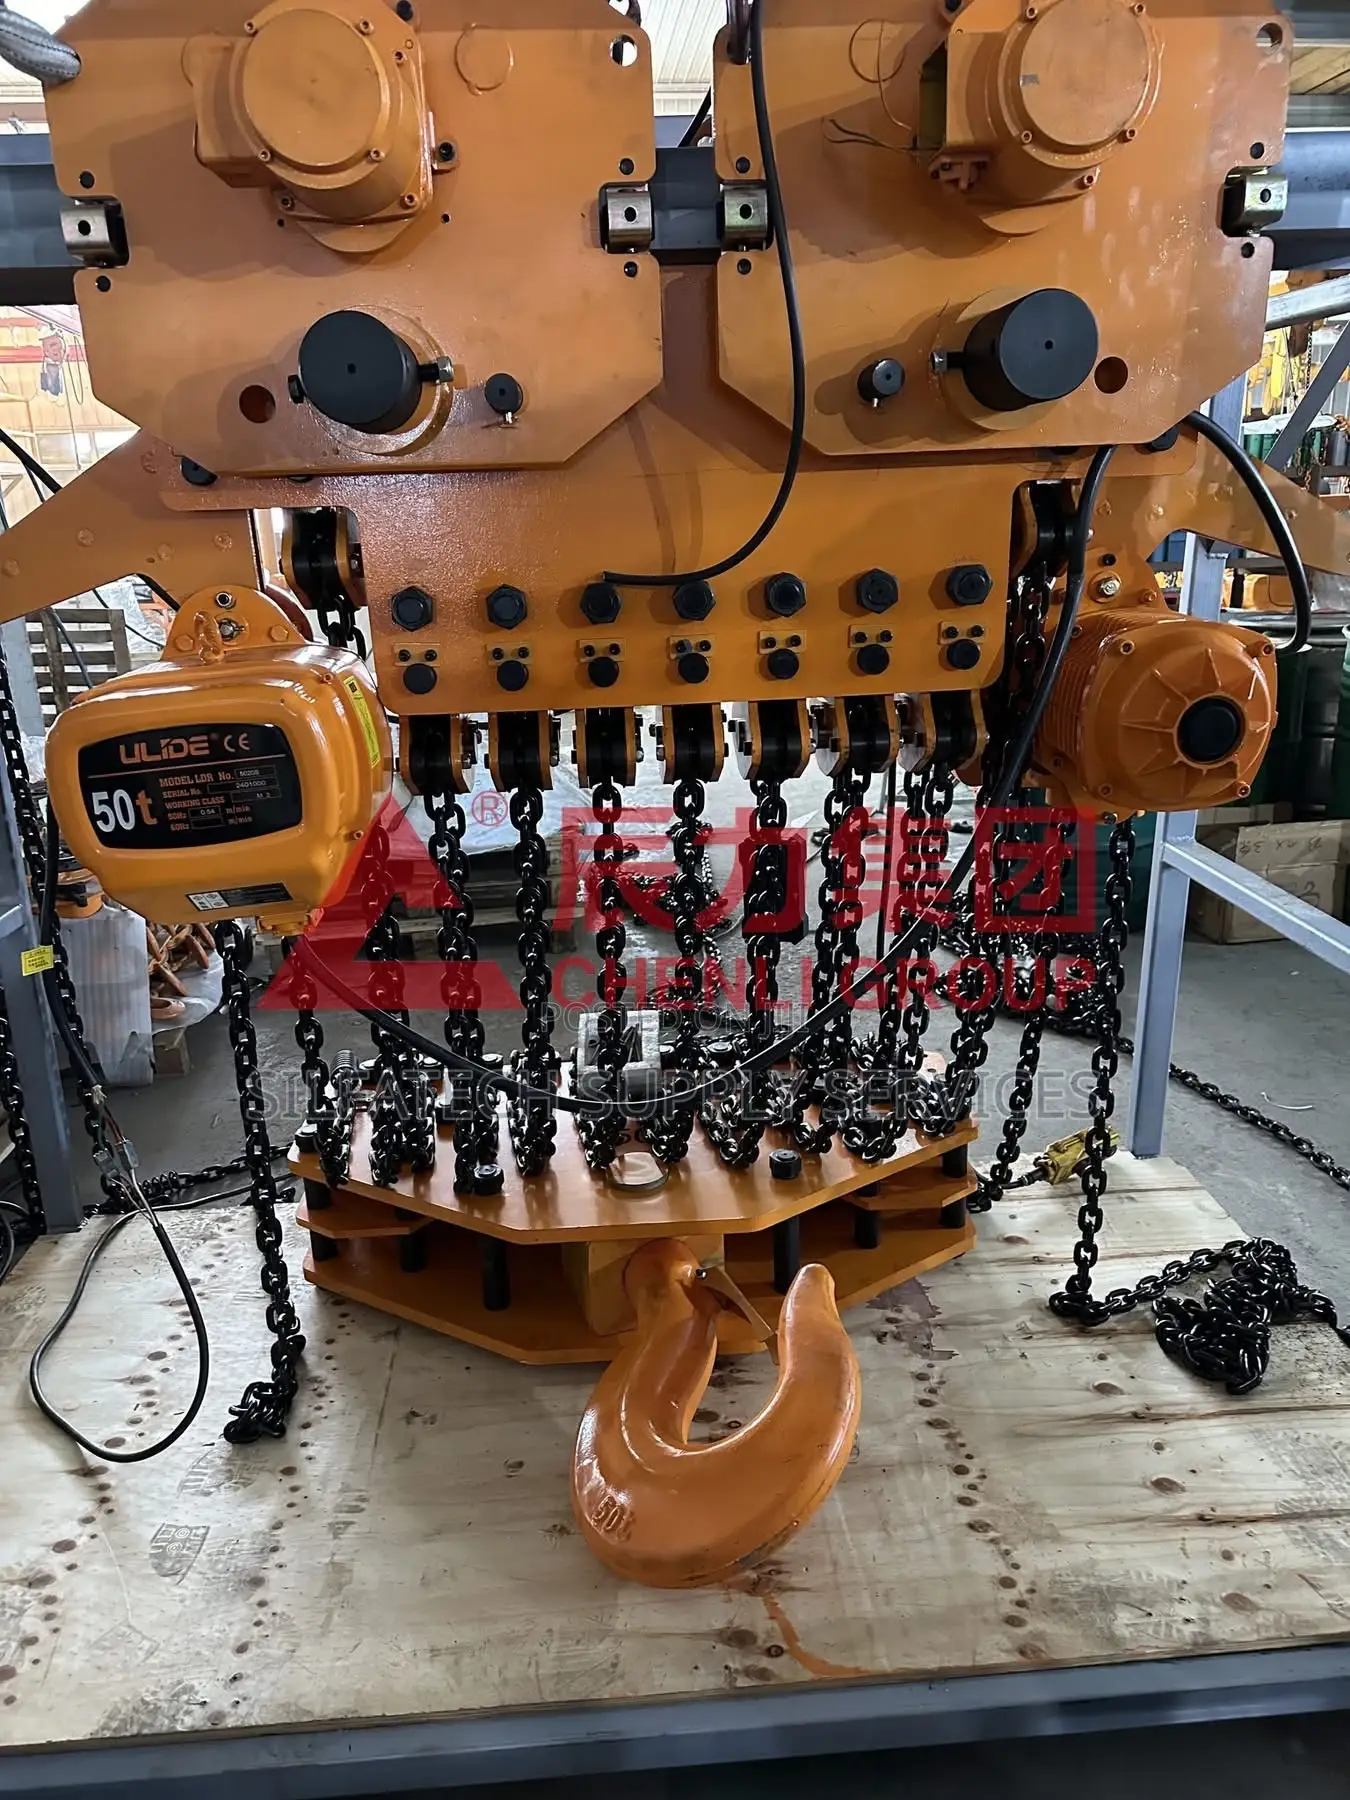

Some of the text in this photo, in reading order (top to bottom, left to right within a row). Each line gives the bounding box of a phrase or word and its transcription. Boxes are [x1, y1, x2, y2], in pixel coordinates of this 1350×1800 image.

[120, 735, 210, 765] ULIDE
[159, 775, 194, 788] MODEL
[194, 772, 215, 783] LDR
[217, 771, 235, 781] No.
[162, 788, 190, 798] SERIAL
[165, 798, 200, 810] WORKING
[201, 796, 226, 806] CLASS
